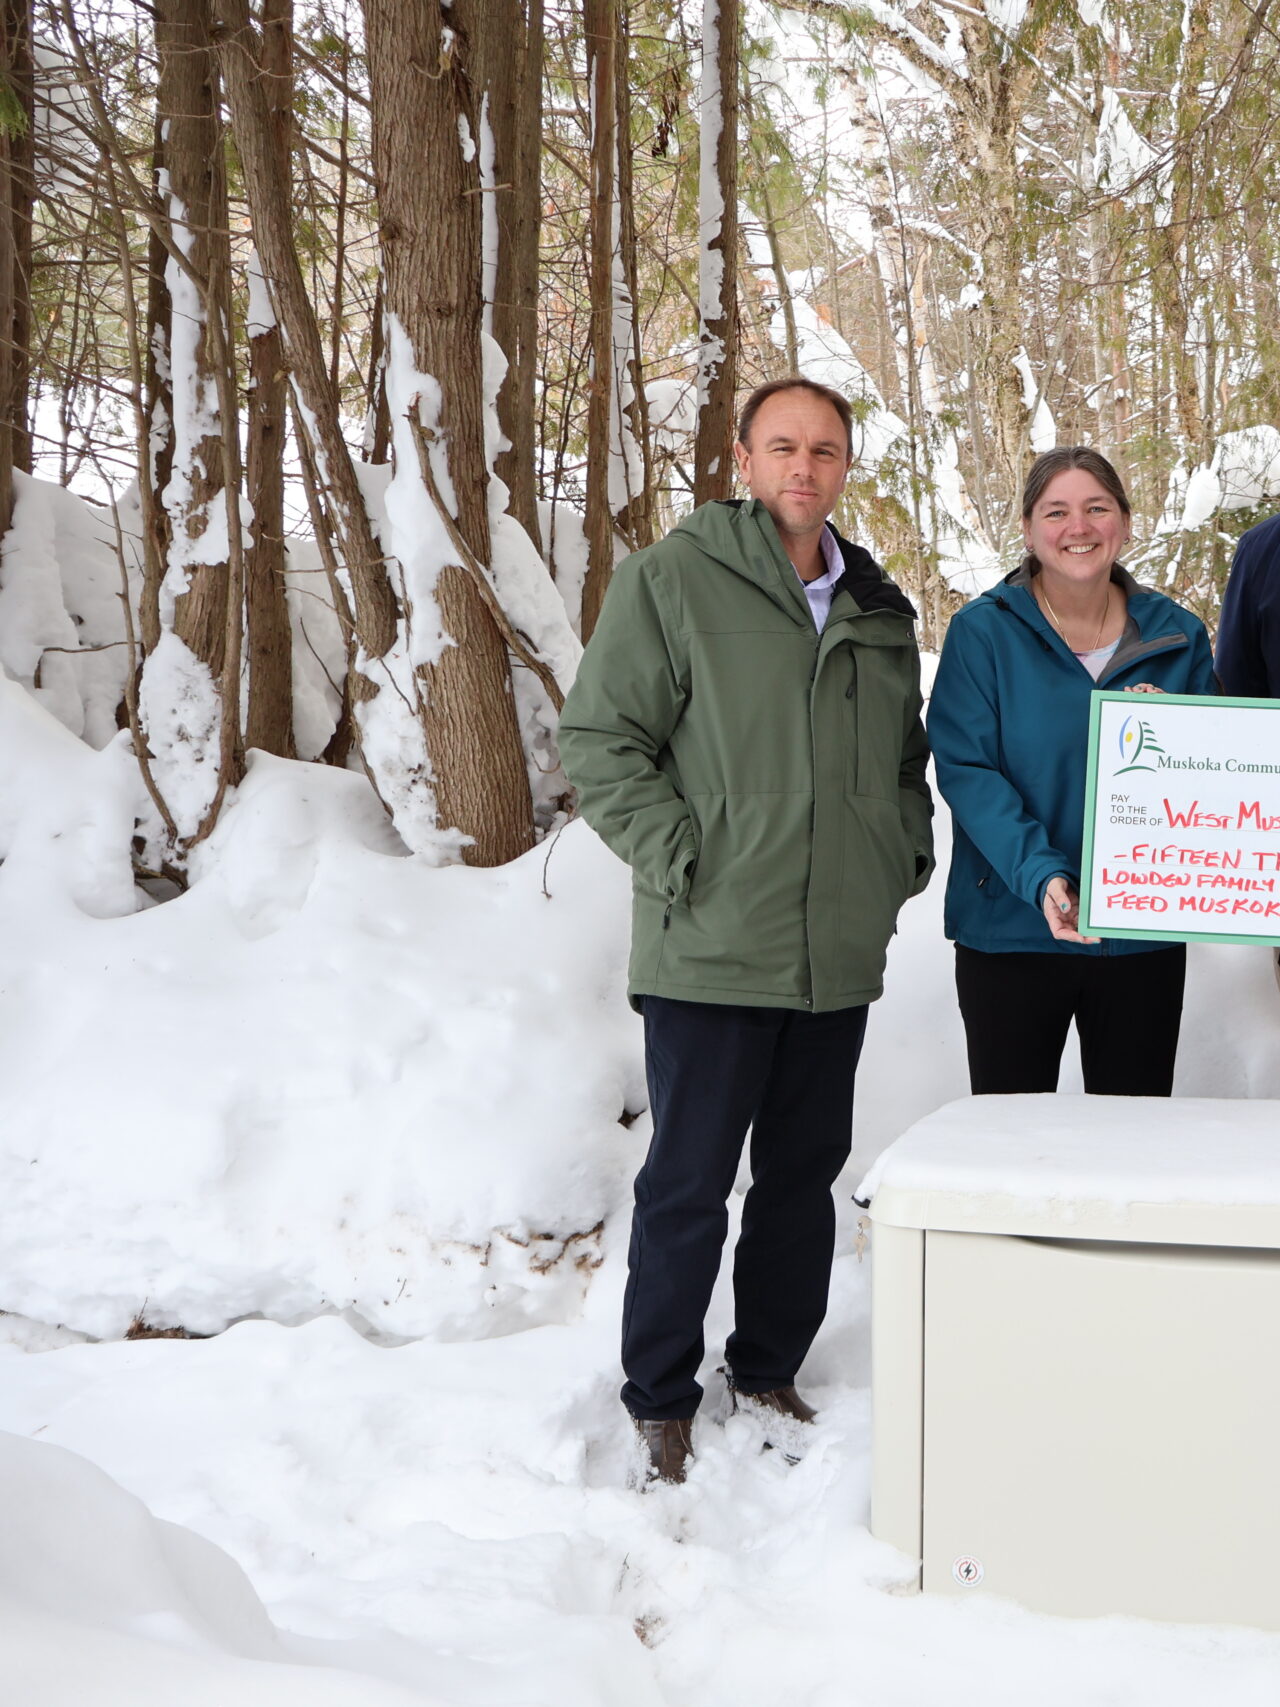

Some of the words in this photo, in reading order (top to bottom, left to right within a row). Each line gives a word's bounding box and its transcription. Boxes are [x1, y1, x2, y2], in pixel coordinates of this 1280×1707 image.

[1157, 755, 1222, 772] Muskoka
[1111, 794, 1130, 803] PAY
[1111, 805, 1125, 815] TO
[1128, 806, 1148, 815] THE
[1109, 815, 1147, 826] ORDER
[1149, 817, 1164, 827] OF
[1102, 868, 1192, 888] LOWDEN
[1197, 872, 1275, 893] FAMILY
[1107, 891, 1169, 912] FEED
